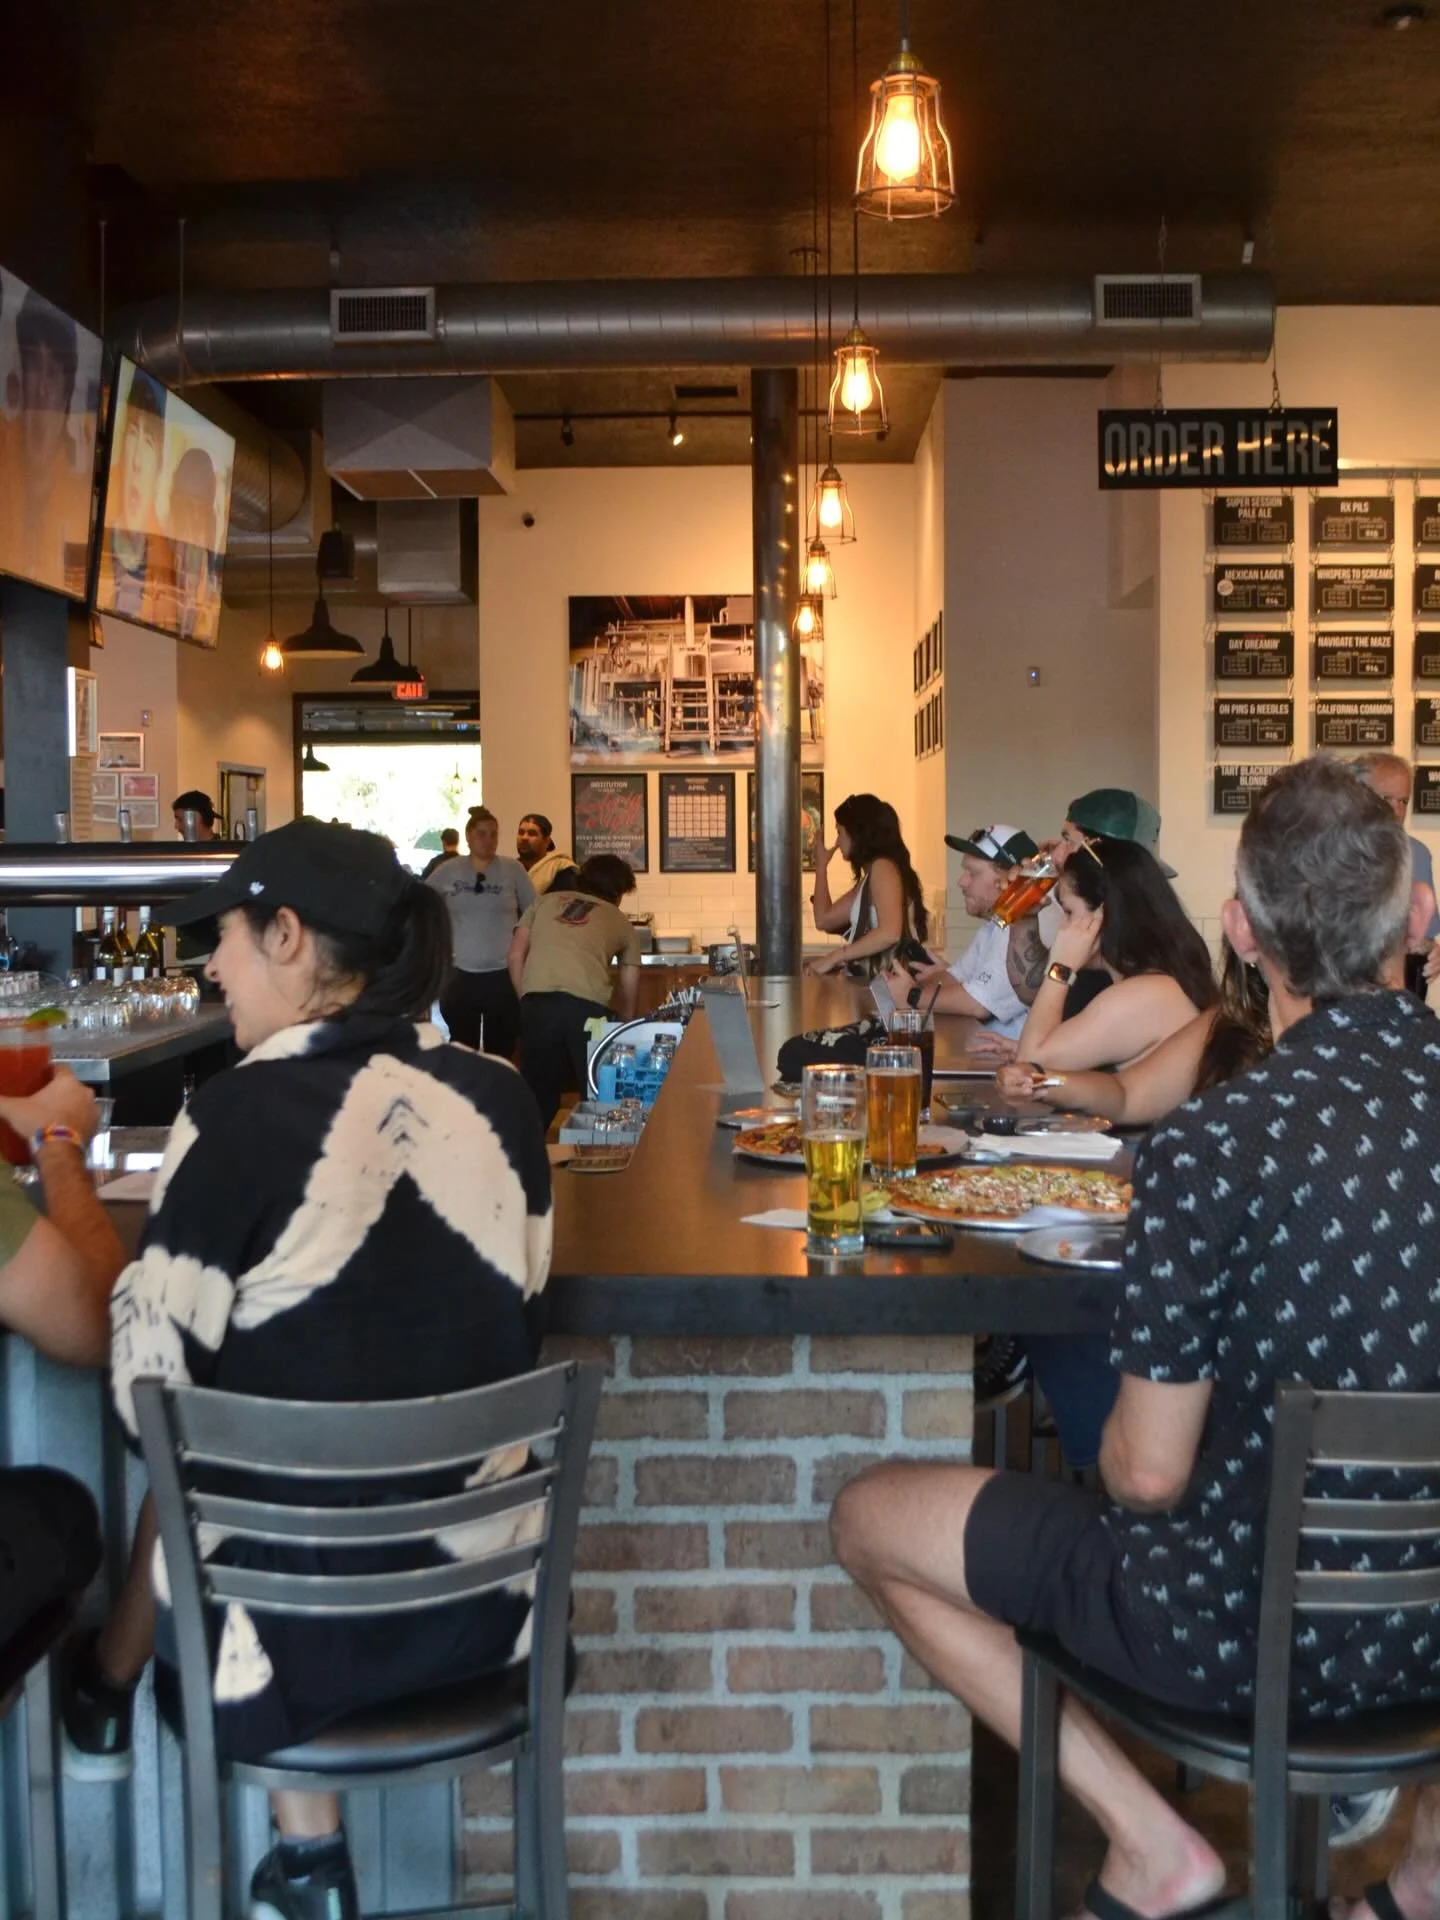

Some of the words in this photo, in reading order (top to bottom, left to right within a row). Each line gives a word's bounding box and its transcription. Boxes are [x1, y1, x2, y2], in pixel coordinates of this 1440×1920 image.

[1104, 420, 1225, 477] ORDER
[1237, 419, 1332, 475] HERE
[1226, 497, 1250, 508] SUPER
[1251, 497, 1282, 507] SESSION
[1353, 501, 1369, 513] PILS
[1238, 508, 1256, 518] PALE
[1258, 508, 1272, 518] ALE
[1225, 569, 1259, 580] MEXICAN
[1260, 569, 1284, 580] LAGER
[1317, 568, 1350, 580] WHISPERS
[1351, 568, 1361, 580] TO
[1362, 568, 1393, 580] SCREAMS
[1228, 639, 1243, 650] DAY
[1318, 636, 1353, 647] NAVIGATE
[1355, 636, 1368, 647] THE
[1370, 636, 1392, 647] MAZE
[1219, 704, 1230, 715] ON
[1231, 704, 1248, 715] PINS
[1257, 704, 1289, 715] NEEDLES
[1317, 704, 1358, 715] CALIFORNIA
[1360, 704, 1393, 715] COMMON
[1221, 766, 1239, 776] TART
[1240, 776, 1268, 786] BLONDE
